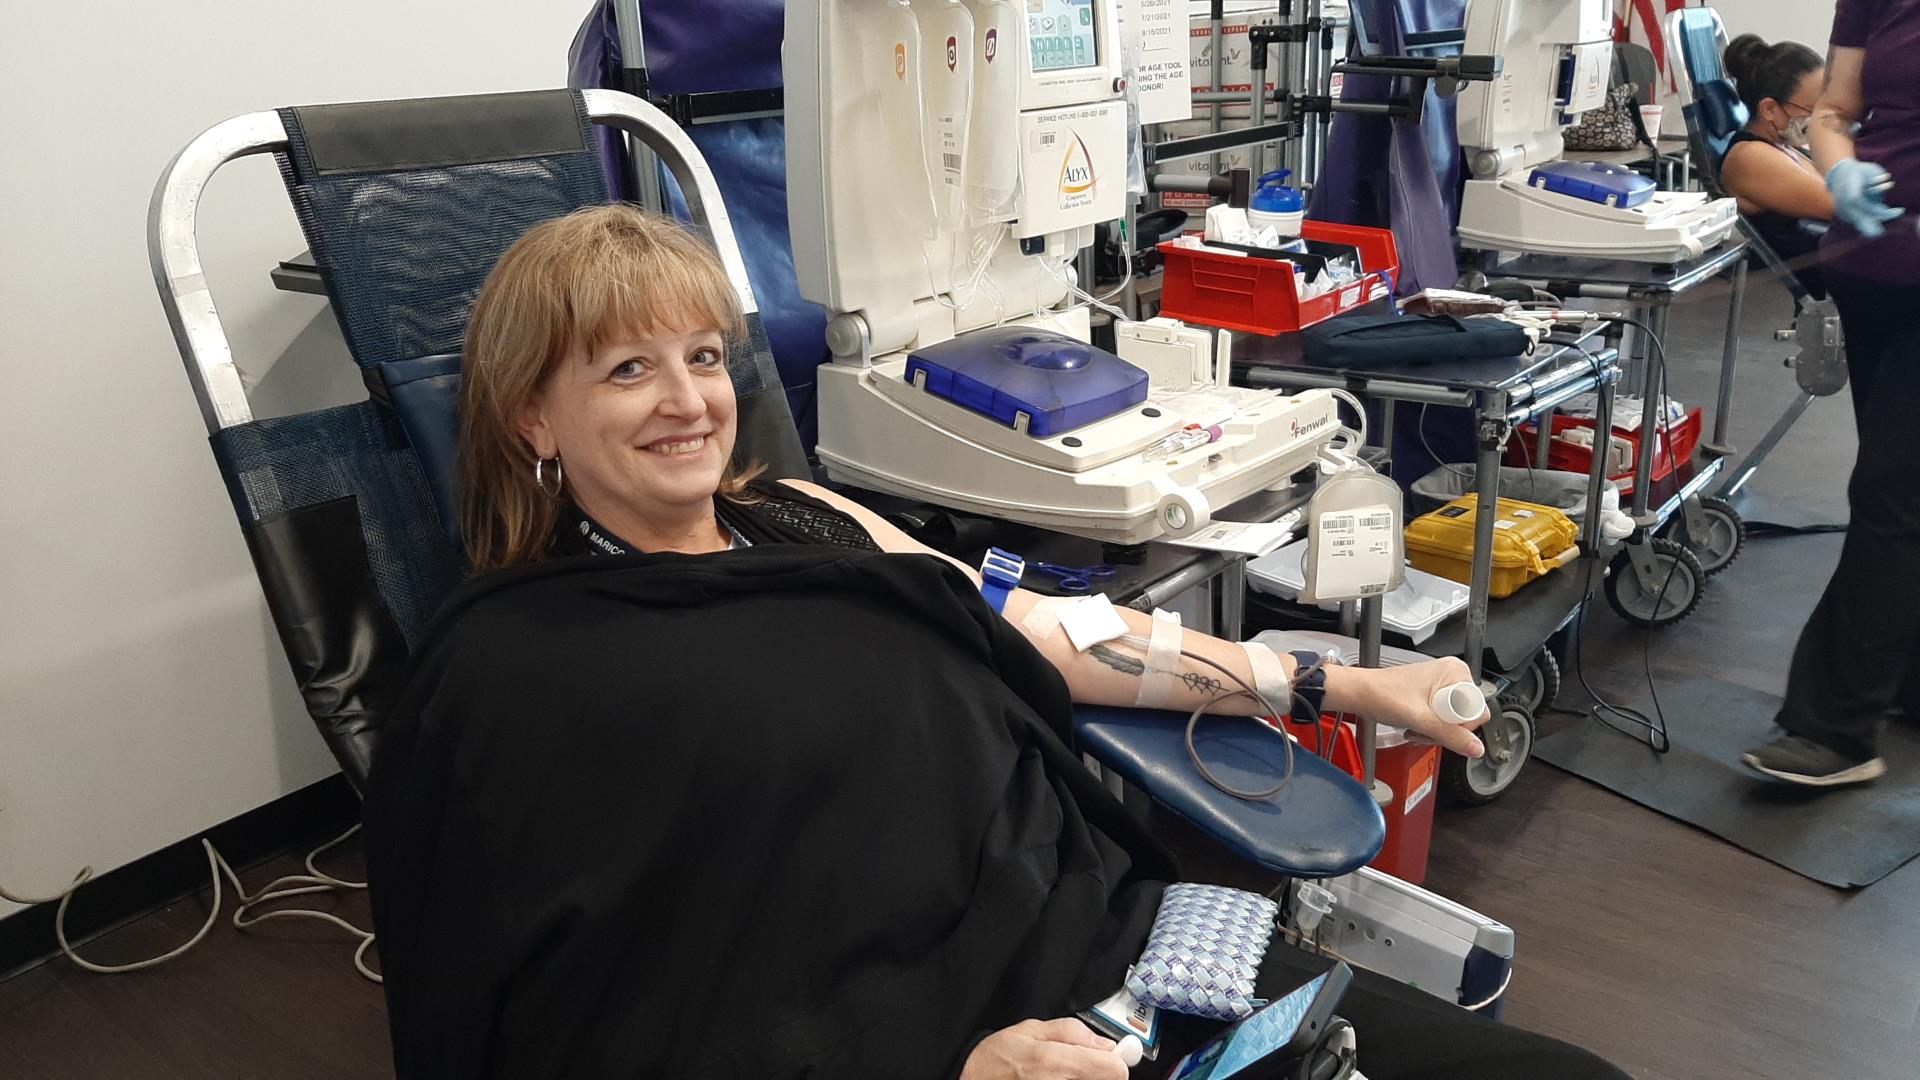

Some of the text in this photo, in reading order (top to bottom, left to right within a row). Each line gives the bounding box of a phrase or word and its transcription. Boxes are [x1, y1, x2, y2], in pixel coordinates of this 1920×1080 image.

[1148, 63, 1162, 71] AGE
[1164, 62, 1182, 70] TOOL
[1063, 165, 1088, 184] ALYX
[1295, 412, 1328, 438] Fenwal
